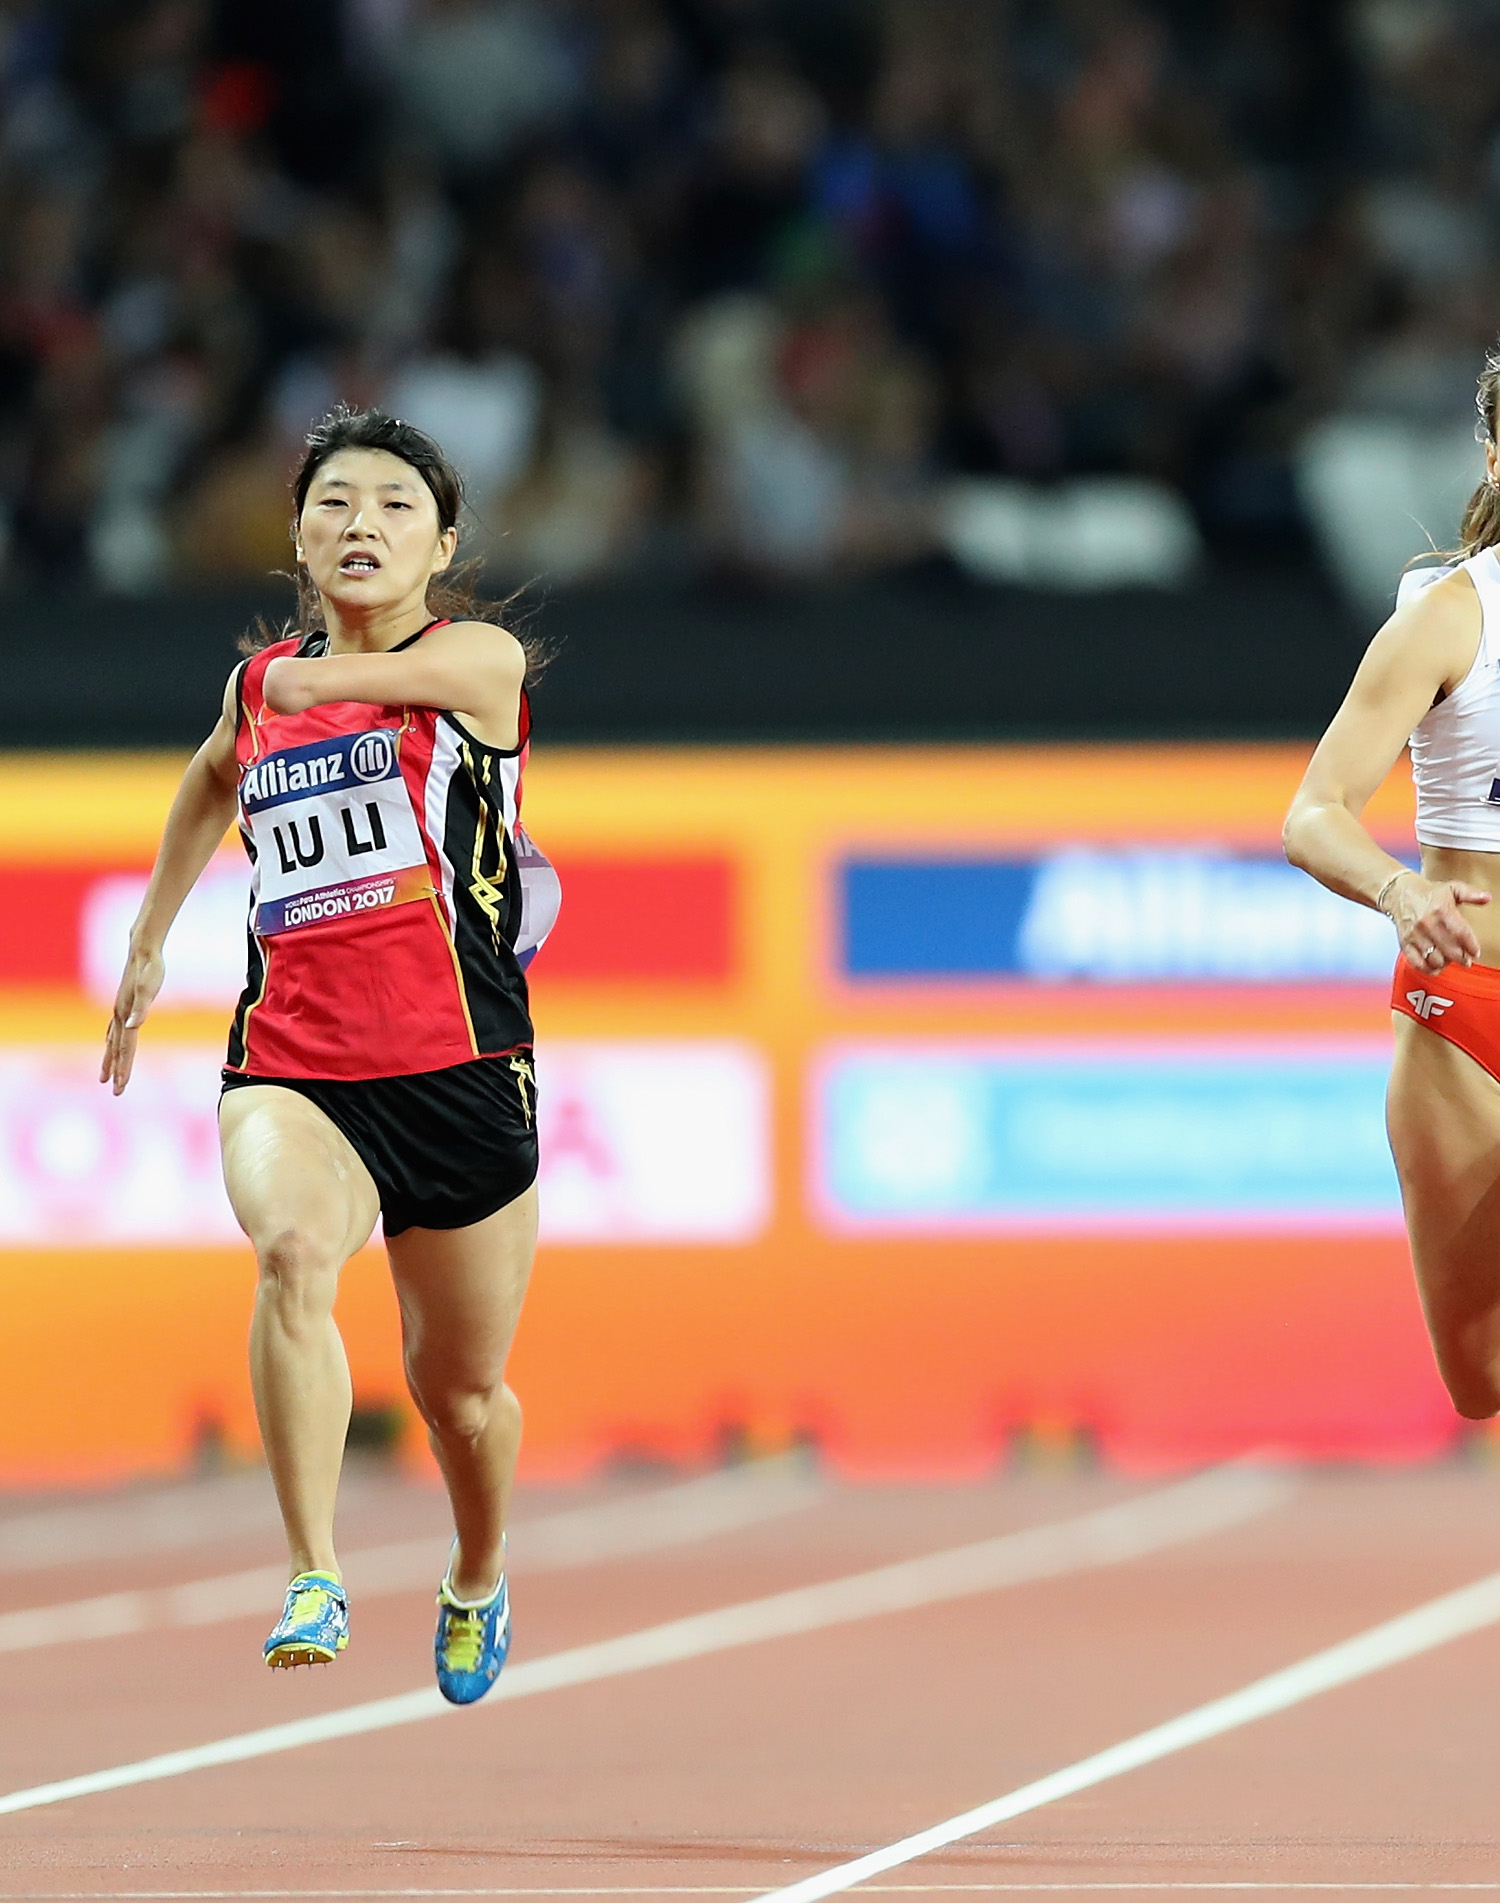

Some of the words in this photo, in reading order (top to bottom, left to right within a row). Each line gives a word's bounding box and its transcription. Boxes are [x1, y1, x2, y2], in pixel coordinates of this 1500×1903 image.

[244, 753, 345, 804] Allianz
[273, 815, 324, 874] LU
[341, 802, 387, 857] LI
[285, 895, 352, 927] LONDON
[352, 885, 395, 910] 2017
[300, 896, 314, 905] Para
[315, 888, 345, 901] Athletics
